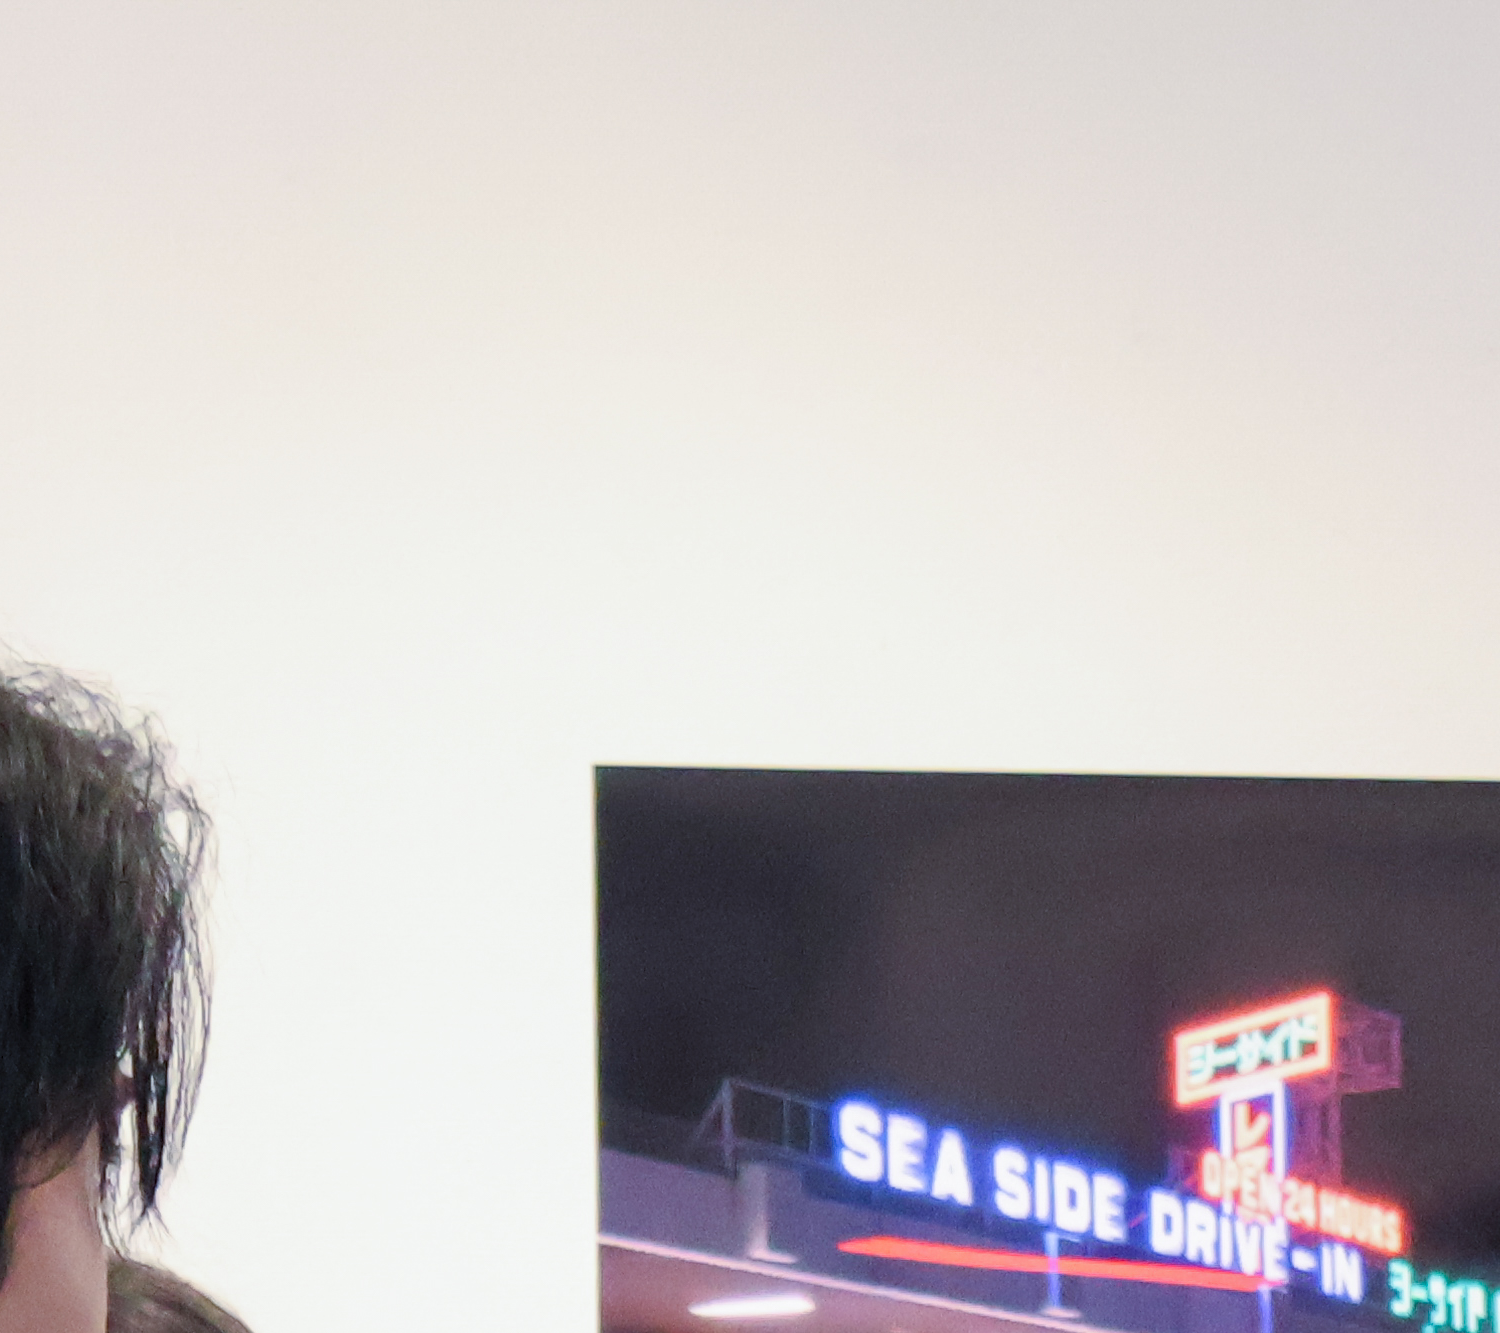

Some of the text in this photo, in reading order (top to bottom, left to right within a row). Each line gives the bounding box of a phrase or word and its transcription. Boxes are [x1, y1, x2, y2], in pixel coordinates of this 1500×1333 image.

[837, 1099, 974, 1208] SEA
[992, 1145, 1129, 1243] SIDE
[1201, 1149, 1403, 1254] OPEN 24 HOURS
